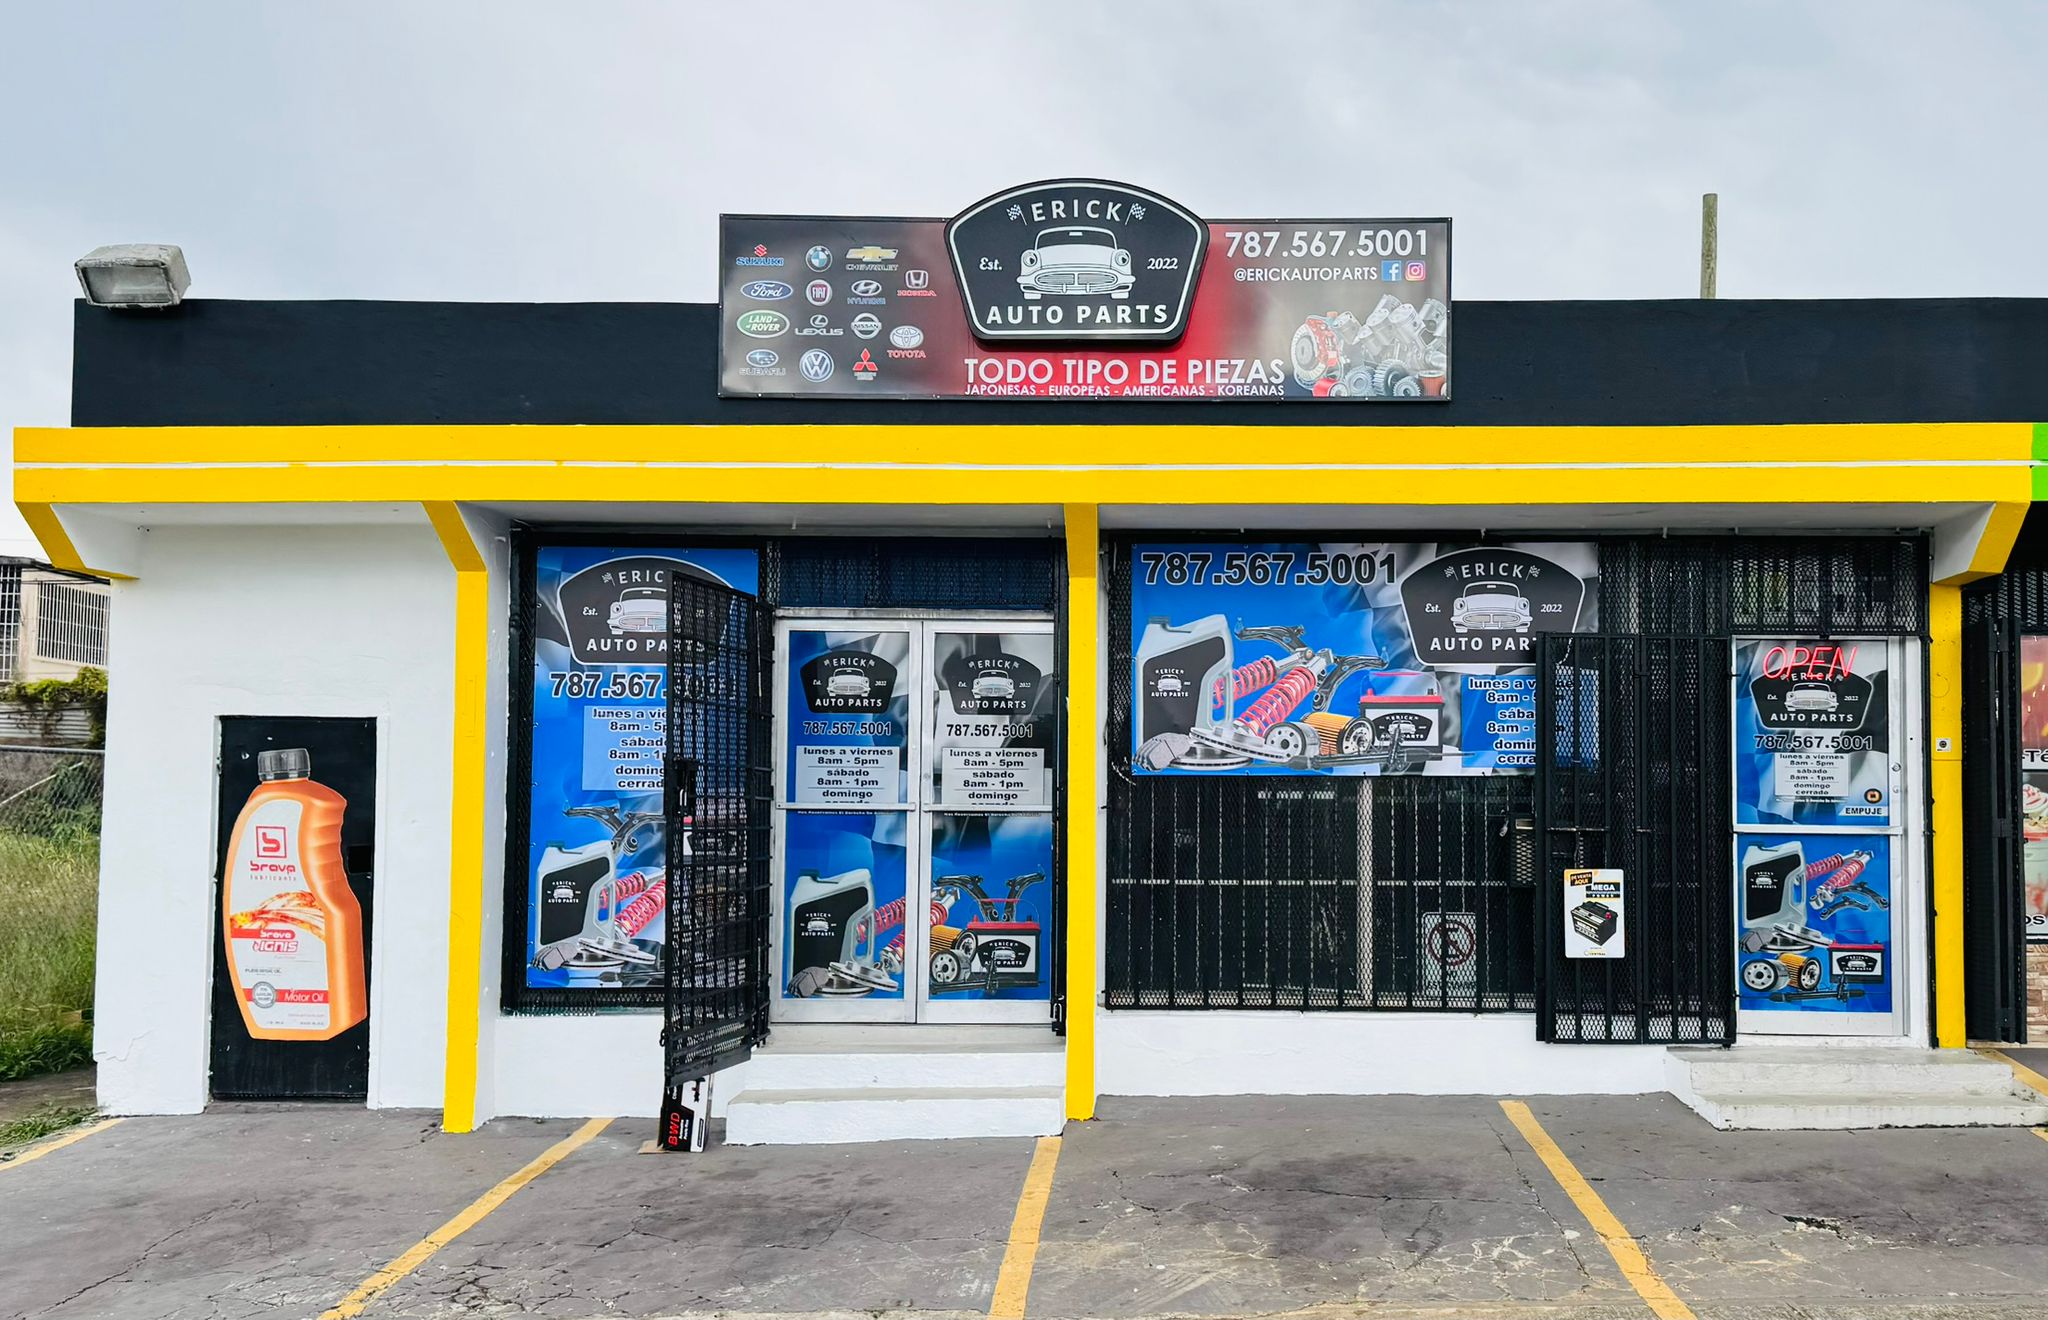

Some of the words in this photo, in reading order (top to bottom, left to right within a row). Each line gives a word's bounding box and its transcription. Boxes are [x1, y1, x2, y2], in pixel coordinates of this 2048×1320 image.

[1031, 199, 1122, 222] ERICK
[1225, 229, 1428, 258] 787.567.5001
[979, 257, 1003, 271] Est.
[1147, 257, 1178, 270] 2022
[1234, 267, 1378, 282] @ERICKAUTOPARTS
[750, 283, 783, 297] Ford
[812, 286, 827, 299] FIAT
[986, 305, 1063, 324] AUTO
[1077, 304, 1168, 323] PARTS
[794, 327, 844, 336] LEXUS
[887, 349, 927, 359] TOYOTA
[964, 358, 1053, 384] TODO
[1063, 359, 1129, 384] TIPO
[1140, 359, 1177, 384] DE
[1187, 359, 1285, 385] PIEZAS
[965, 384, 1036, 396] JAPONESAS
[1048, 385, 1110, 396] EUROPEAS
[1122, 385, 1205, 396] AMERICANAS
[1217, 385, 1285, 396] KOREANAS
[1141, 552, 1398, 585] 787.567.5001
[1461, 562, 1524, 578] ERICK
[618, 570, 665, 584] ERIC
[582, 606, 598, 616] Est.
[1425, 603, 1441, 613] Est.
[1540, 603, 1563, 613] 2022
[586, 638, 638, 651] AUTO
[1430, 637, 1487, 650] AUTO
[1491, 637, 1537, 650] PAR
[833, 657, 867, 668] ERICK
[978, 660, 1011, 669] ERICK
[1763, 646, 1857, 679] OPEN
[1468, 678, 1509, 690] lunes
[1513, 680, 1523, 689] a
[815, 698, 845, 707] AUTO
[848, 698, 883, 707] PARTS
[1486, 692, 1520, 703] 8am
[960, 700, 989, 708] AUTO
[993, 700, 1027, 708] PARTS
[593, 708, 631, 719] lunes
[636, 710, 645, 719] a
[1498, 708, 1536, 720] sába
[1770, 713, 1806, 722] AUTO
[1811, 713, 1854, 722] PARTS
[609, 721, 640, 731] 8am
[653, 721, 667, 733] 5p
[803, 721, 892, 736] 787.567.5001
[946, 723, 1033, 738] 787.567.5001
[1486, 722, 1519, 733] 8am
[1494, 739, 1536, 751] domi
[1754, 734, 1873, 750] 787.567.5001
[609, 749, 640, 759] 8am
[803, 747, 836, 755] lunes
[849, 747, 893, 756] viernes
[950, 749, 981, 757] lunes
[995, 750, 1038, 758] viernes
[817, 757, 845, 765] 8am
[853, 757, 879, 767] 5pm
[963, 759, 989, 767] 8am
[999, 759, 1024, 768] 5pm
[1497, 754, 1536, 764] cerra
[615, 765, 664, 777] doming
[827, 767, 870, 777] sábado
[618, 780, 664, 789] cerrad
[817, 778, 844, 786] 8am
[854, 778, 879, 787] 1pm
[963, 780, 989, 788] 8am
[999, 780, 1024, 789] 1pm
[1794, 782, 1831, 790] domingo
[822, 789, 873, 799] domingo
[968, 791, 1018, 801] domingo
[1845, 807, 1882, 815] EMPUJE
[250, 860, 296, 873] brava
[284, 991, 309, 1002] Motor
[311, 992, 324, 1002] Oil
[668, 1112, 680, 1146] BWD
